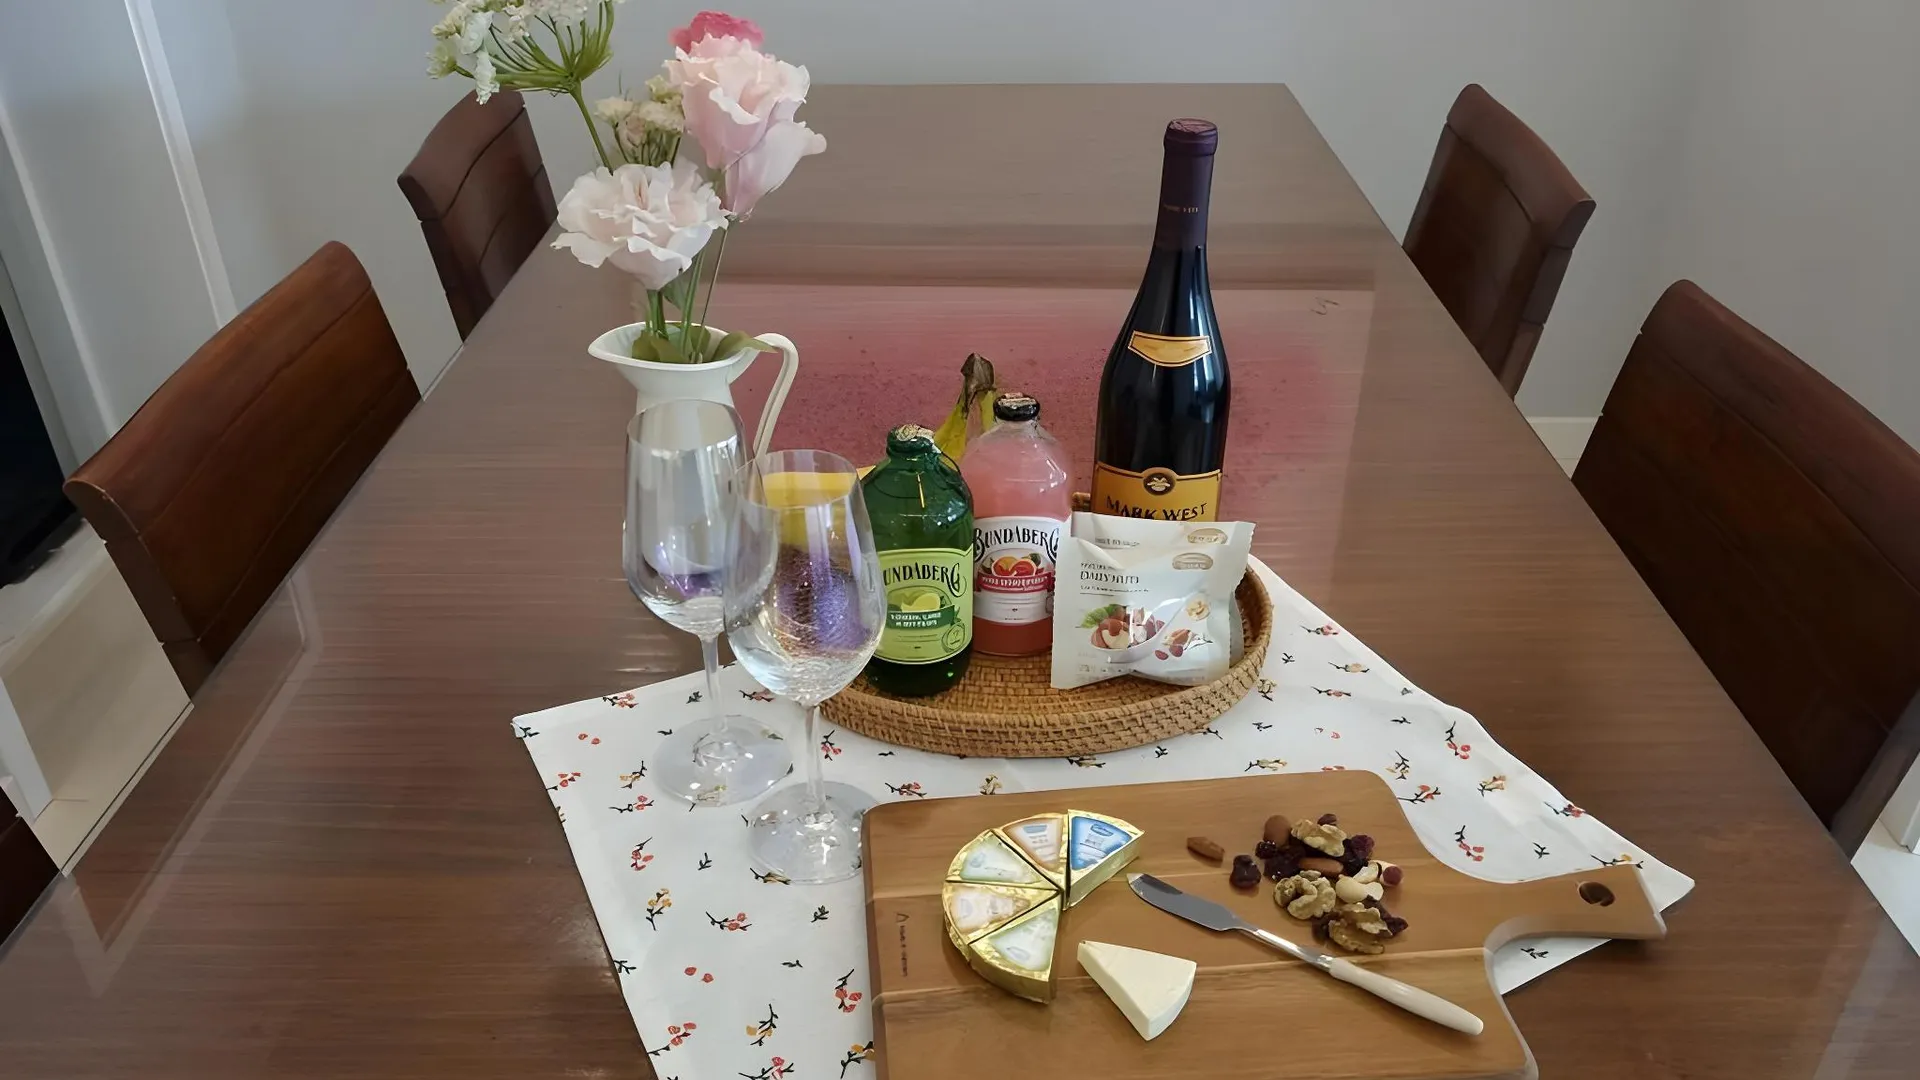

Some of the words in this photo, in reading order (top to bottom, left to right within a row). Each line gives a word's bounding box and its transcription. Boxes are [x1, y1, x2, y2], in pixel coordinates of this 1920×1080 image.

[1107, 496, 1157, 520] MARK
[1162, 502, 1208, 521] WEST
[883, 562, 964, 597] UNDABERG
